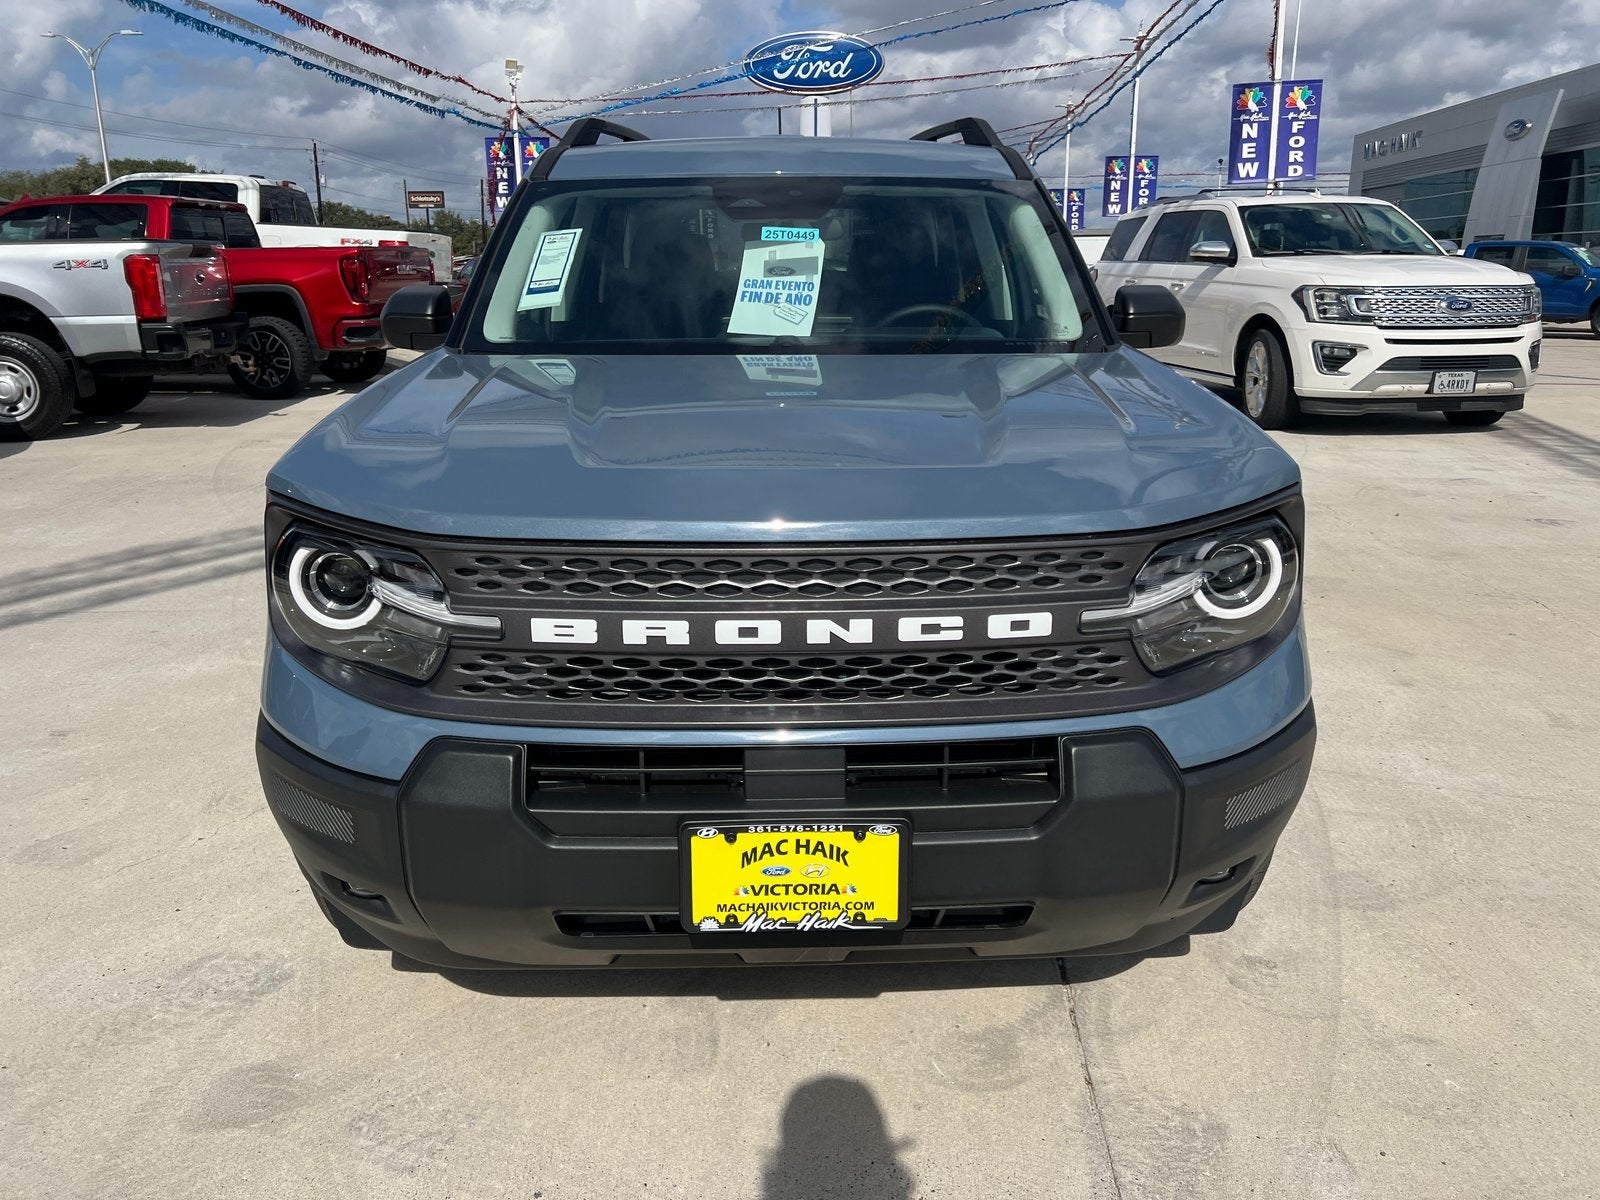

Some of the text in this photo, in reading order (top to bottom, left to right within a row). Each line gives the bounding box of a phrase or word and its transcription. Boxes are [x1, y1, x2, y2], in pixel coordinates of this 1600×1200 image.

[773, 44, 854, 80] Ford
[1237, 122, 1259, 178] NEW
[1287, 121, 1306, 177] FORD
[1107, 180, 1122, 214] NEW
[1138, 180, 1150, 205] FOR
[1071, 205, 1080, 231] FORD
[340, 238, 374, 246] FX4
[764, 229, 816, 241] 25T0449
[743, 278, 815, 292] GRAN EVENTO
[740, 291, 813, 307] FIN DE AÑO
[1451, 301, 1468, 309] Ford
[530, 611, 1053, 646] BRONCO
[748, 824, 844, 833] 361-576-1221
[874, 825, 893, 834] Ford
[741, 838, 850, 869] MAC HAIK
[766, 866, 786, 876] Ford
[750, 883, 841, 896] VICTORIA
[716, 901, 875, 913] MACHAIKVICTORIA.COM
[742, 911, 854, 933] Mac Haik
